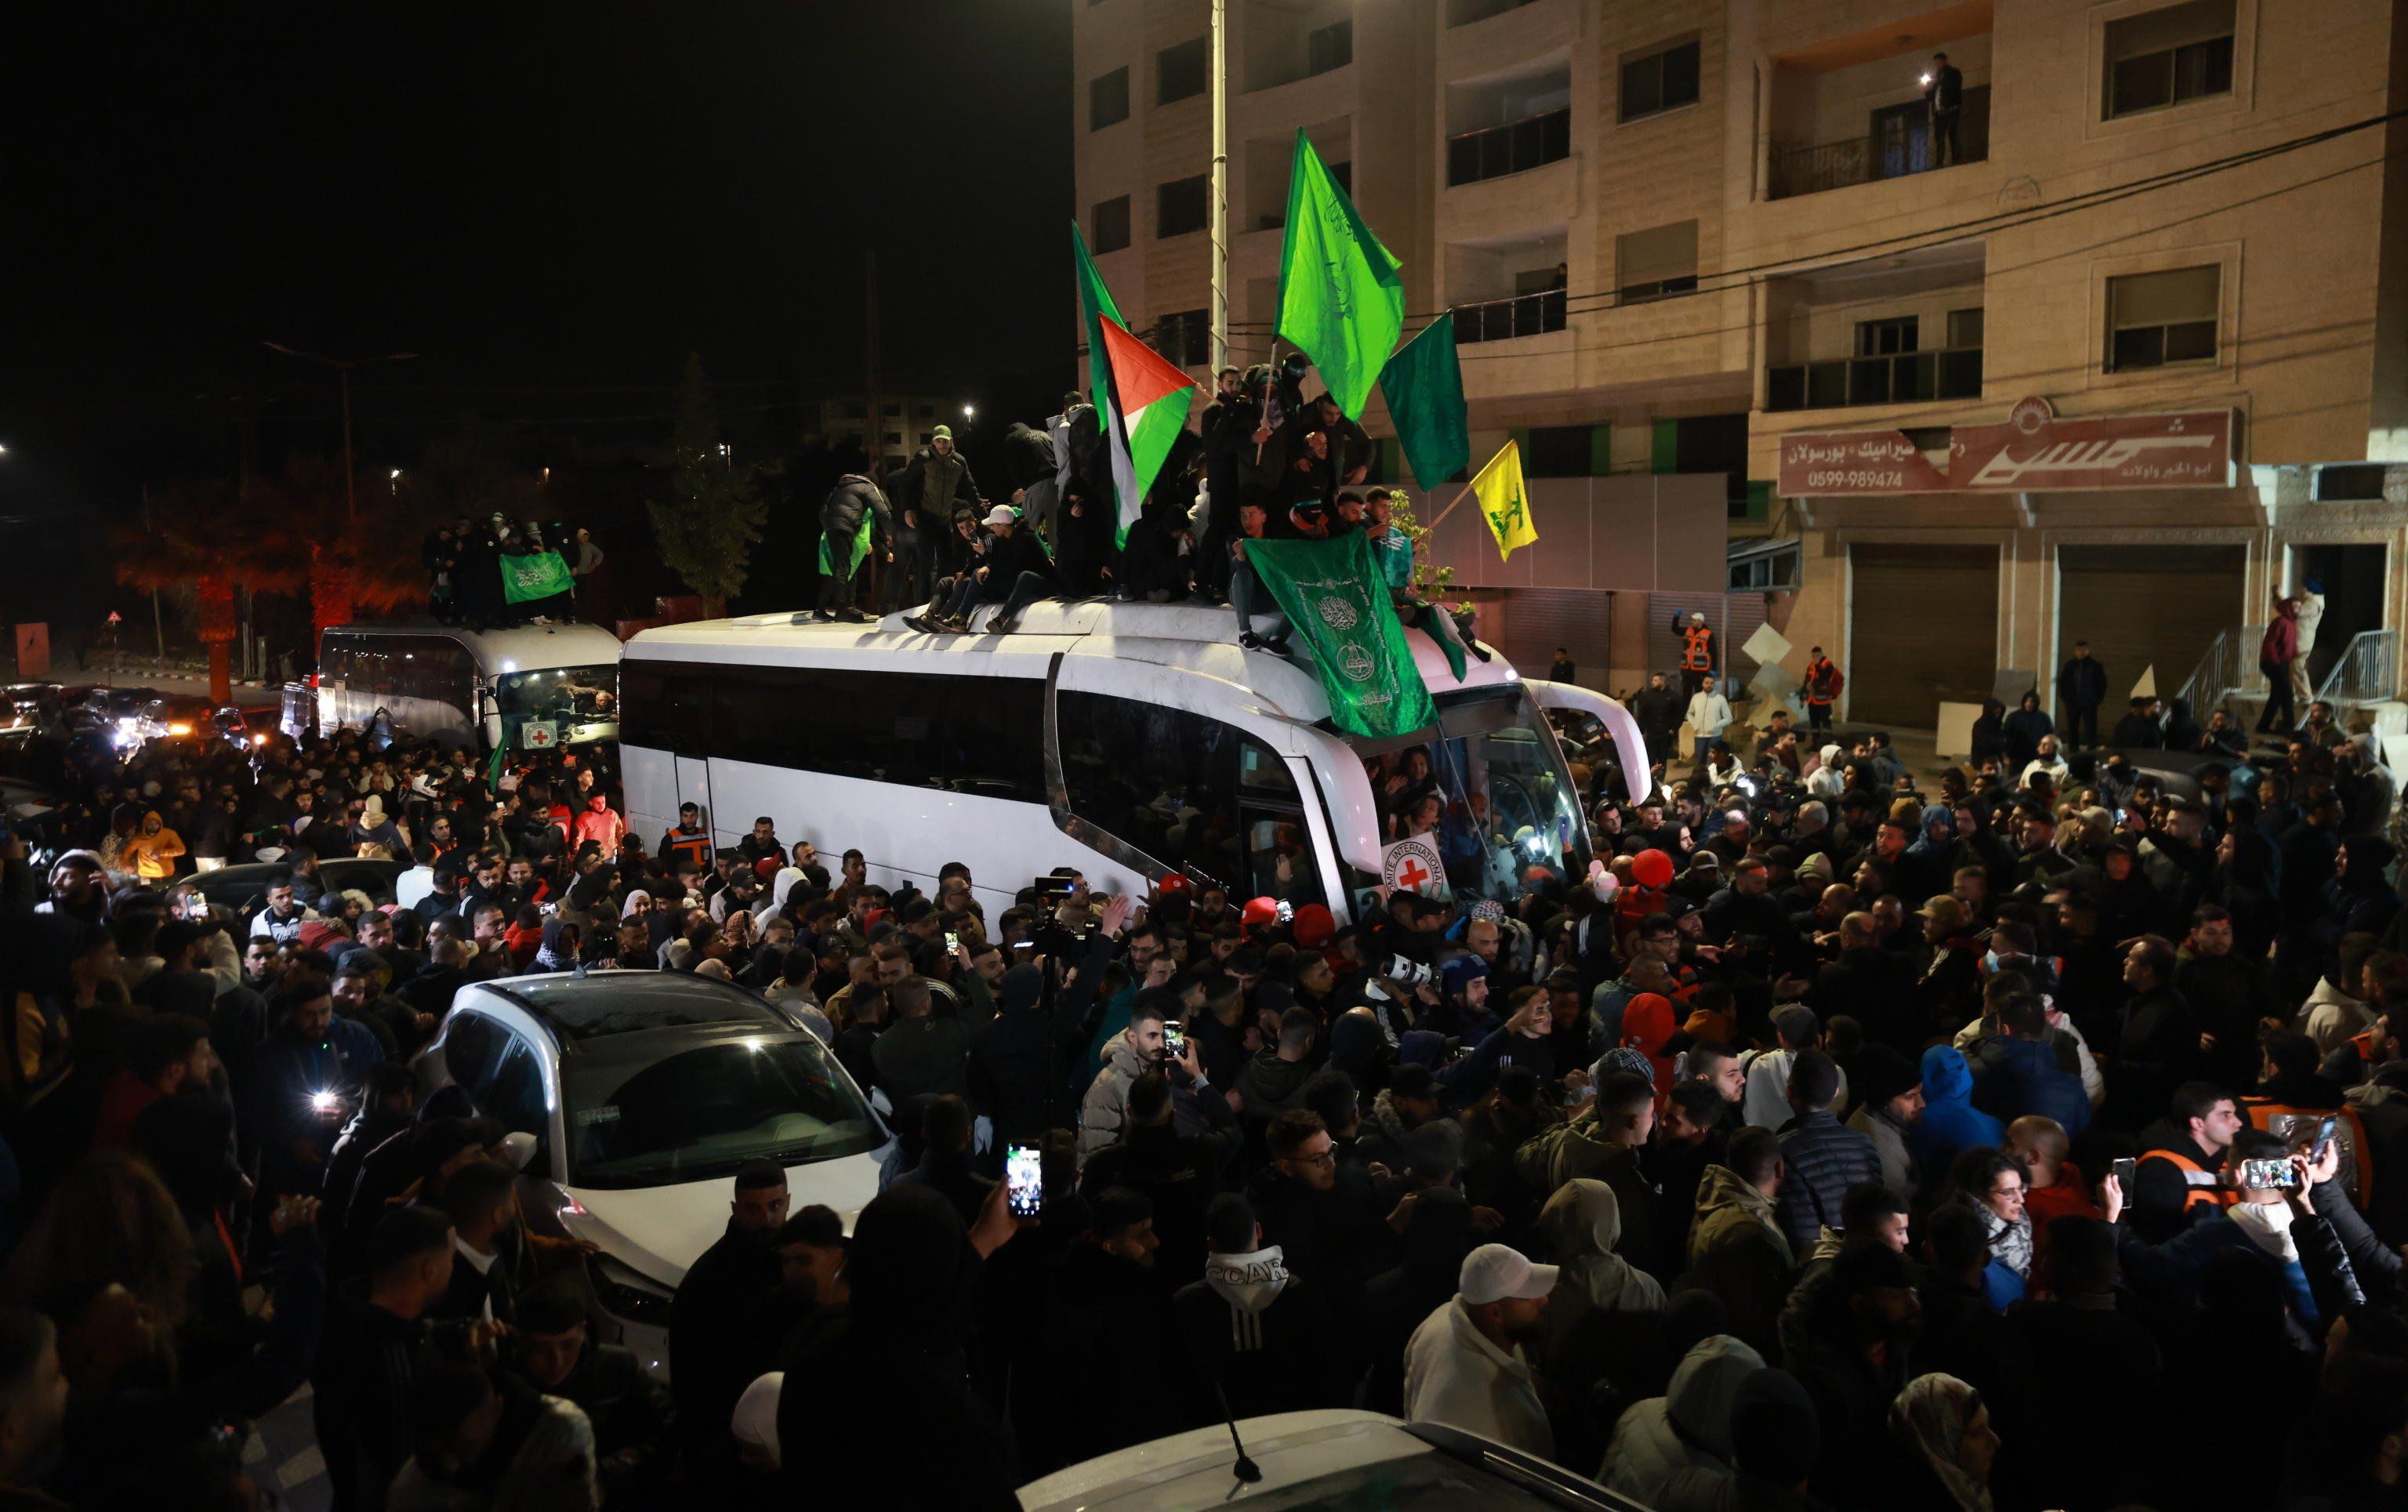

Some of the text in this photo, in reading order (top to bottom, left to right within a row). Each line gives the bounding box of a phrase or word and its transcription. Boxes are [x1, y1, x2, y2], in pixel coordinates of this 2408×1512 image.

[1788, 443, 1845, 464] بورسولان
[1858, 441, 1915, 461] سيراميك
[1808, 471, 1902, 487] 0599-989474
[1387, 843, 1442, 894] OMITE INTERNATIONAL
